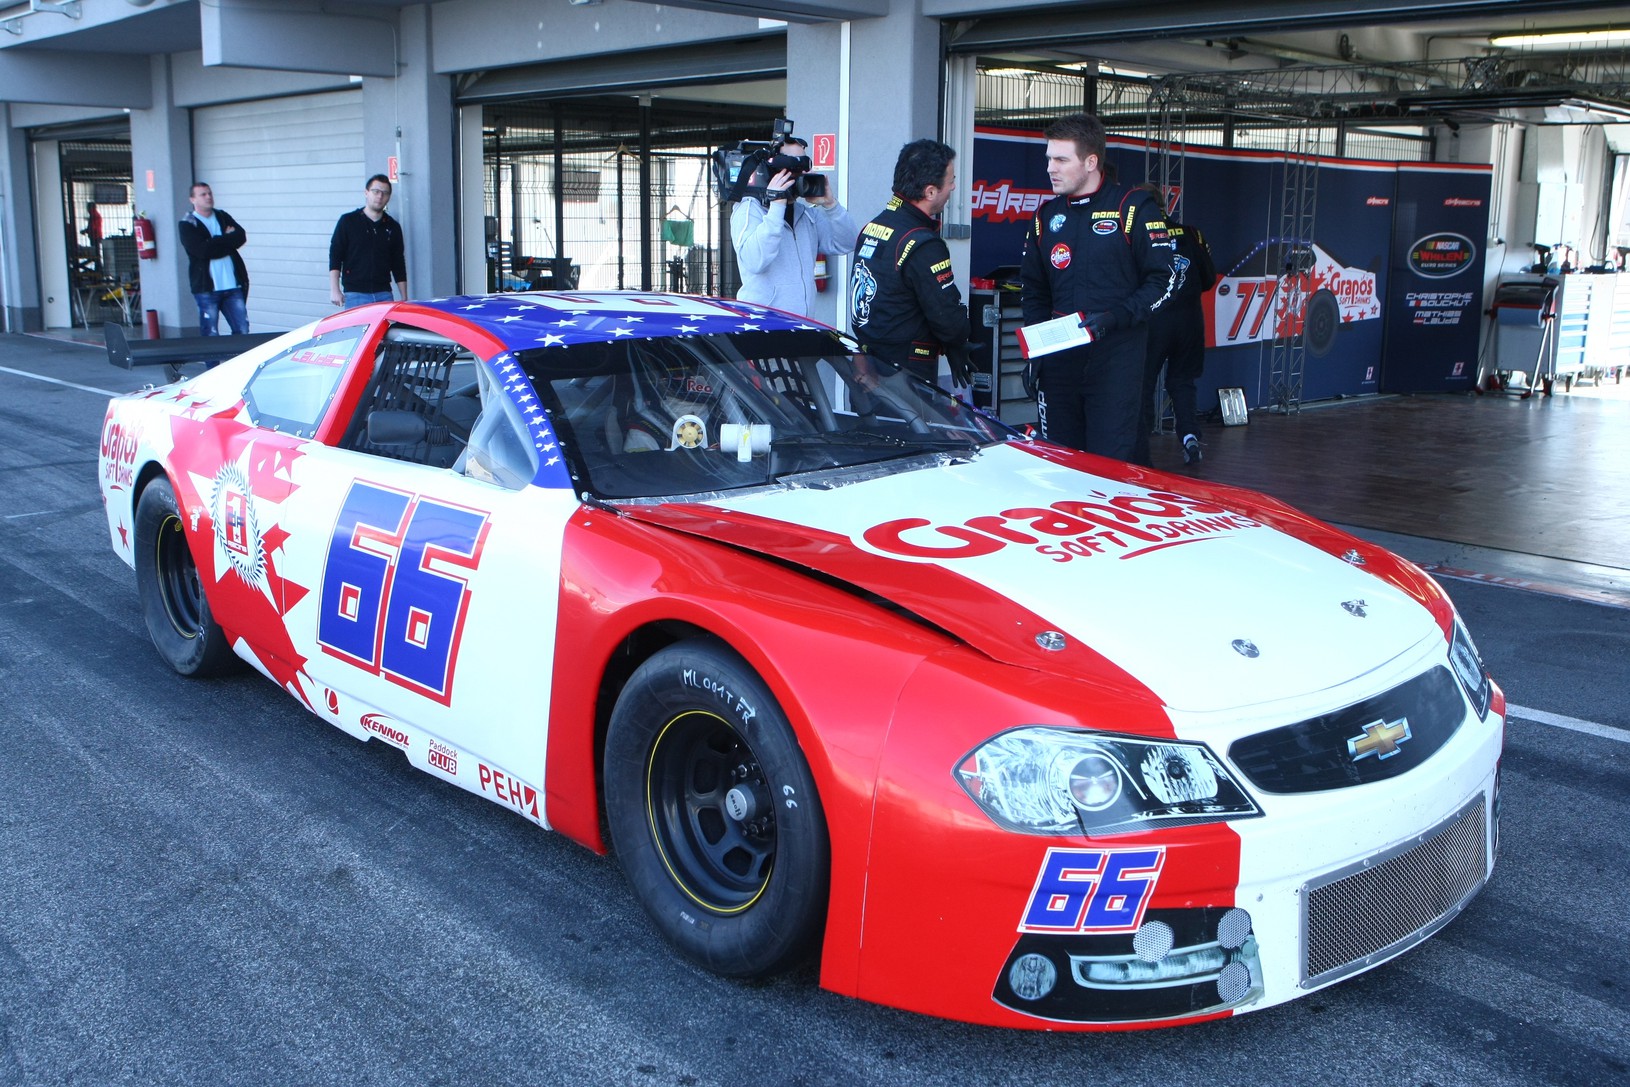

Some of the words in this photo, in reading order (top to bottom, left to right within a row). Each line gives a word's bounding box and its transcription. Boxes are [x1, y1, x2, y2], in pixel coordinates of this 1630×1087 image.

[1436, 241, 1460, 250] NASCAR
[1406, 292, 1473, 300] CHRISTOPHE
[1420, 299, 1471, 307] BOUCHUT
[1035, 530, 1128, 562] SOFT
[1146, 514, 1262, 539] DRINKS
[316, 477, 492, 708] 66
[363, 717, 410, 746] KENNOL
[429, 739, 458, 759] Paddock
[428, 750, 457, 774] CLUB
[1018, 845, 1166, 934] 66
